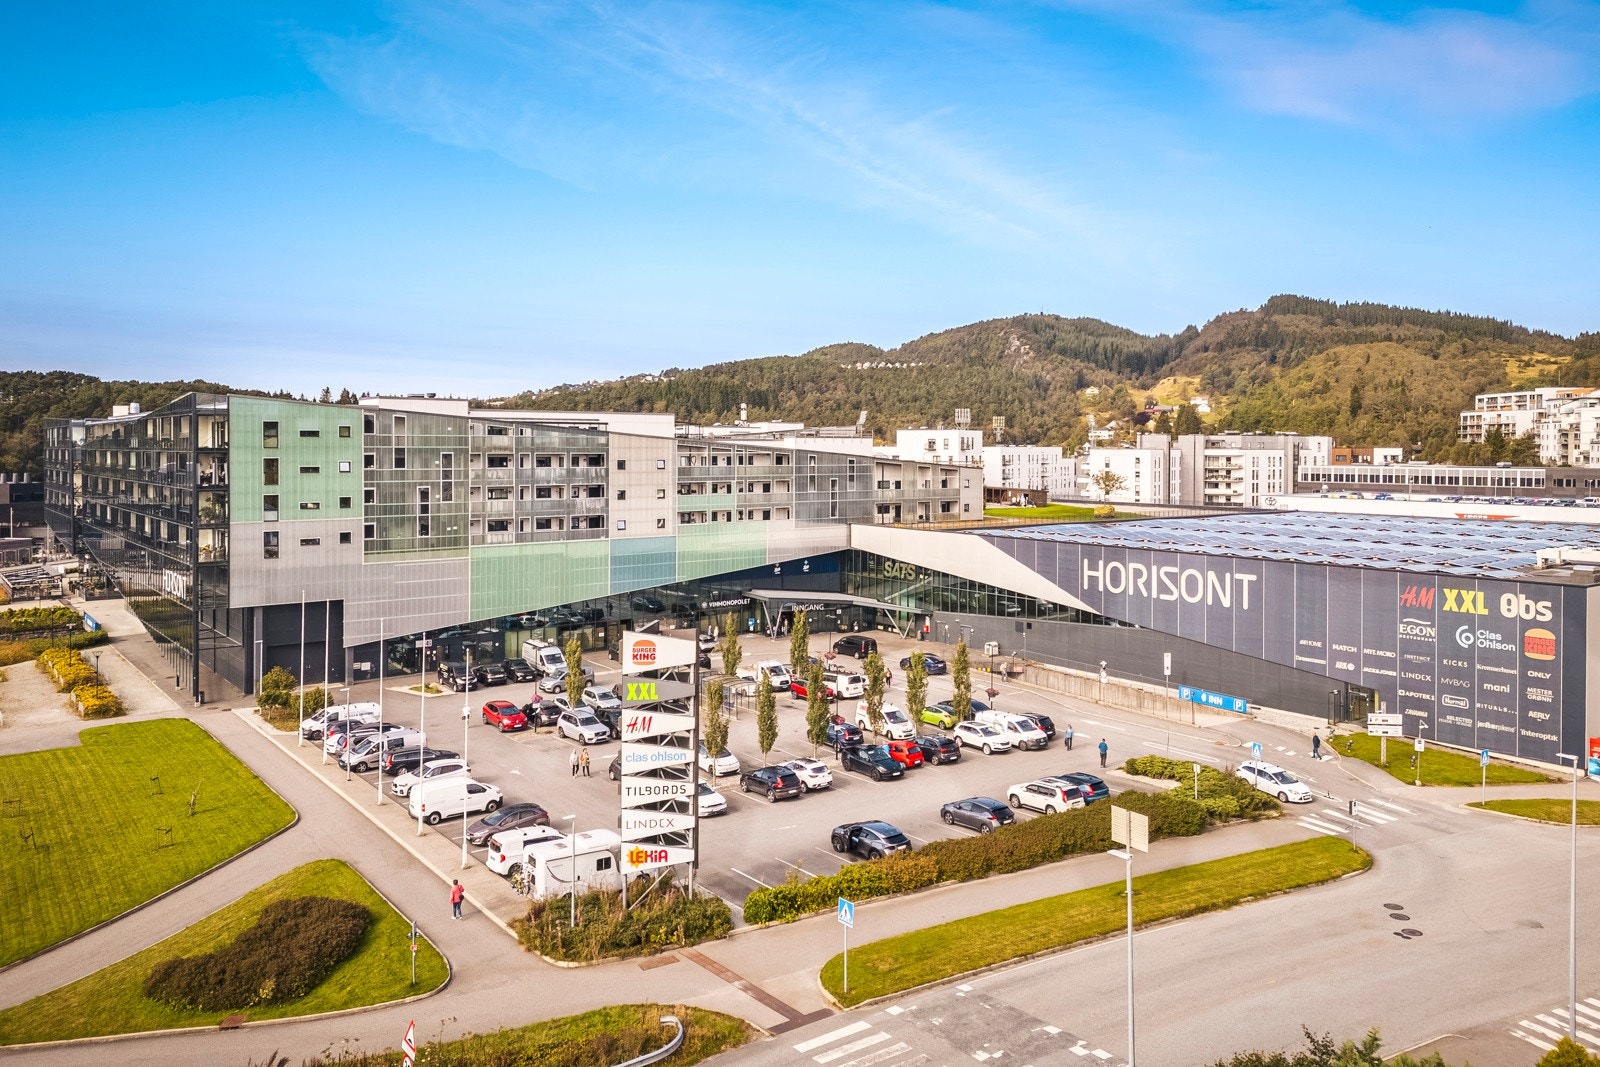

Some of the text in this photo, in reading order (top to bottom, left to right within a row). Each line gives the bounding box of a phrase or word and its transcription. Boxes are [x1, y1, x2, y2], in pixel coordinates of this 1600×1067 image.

[883, 561, 916, 580] SATS
[1083, 558, 1257, 611] HORISONT
[708, 598, 751, 607] VINMONOPOLET
[1400, 585, 1435, 610] H&M
[1442, 588, 1489, 616] XXL
[791, 603, 824, 612] INNGANG
[1399, 624, 1436, 638] EGON
[1477, 629, 1502, 640] Clas
[1399, 634, 1436, 643] RESTAURANT
[1332, 643, 1357, 653] MATCH
[1477, 639, 1515, 652] Ohlson
[1524, 642, 1556, 656] KING
[632, 653, 656, 661] KING
[1443, 658, 1468, 668] KICKS
[1401, 671, 1431, 682] LINDEX
[1527, 670, 1552, 680] ONLY
[626, 682, 659, 701] XXL
[1483, 683, 1510, 693] mani
[1208, 695, 1222, 706] INN
[1405, 691, 1430, 700] APOTEK
[1444, 696, 1466, 707] Normal
[626, 716, 653, 734] H&M
[625, 750, 687, 763] clas ohlson
[625, 785, 687, 796] TILBORDS
[626, 818, 675, 830] LINDEX
